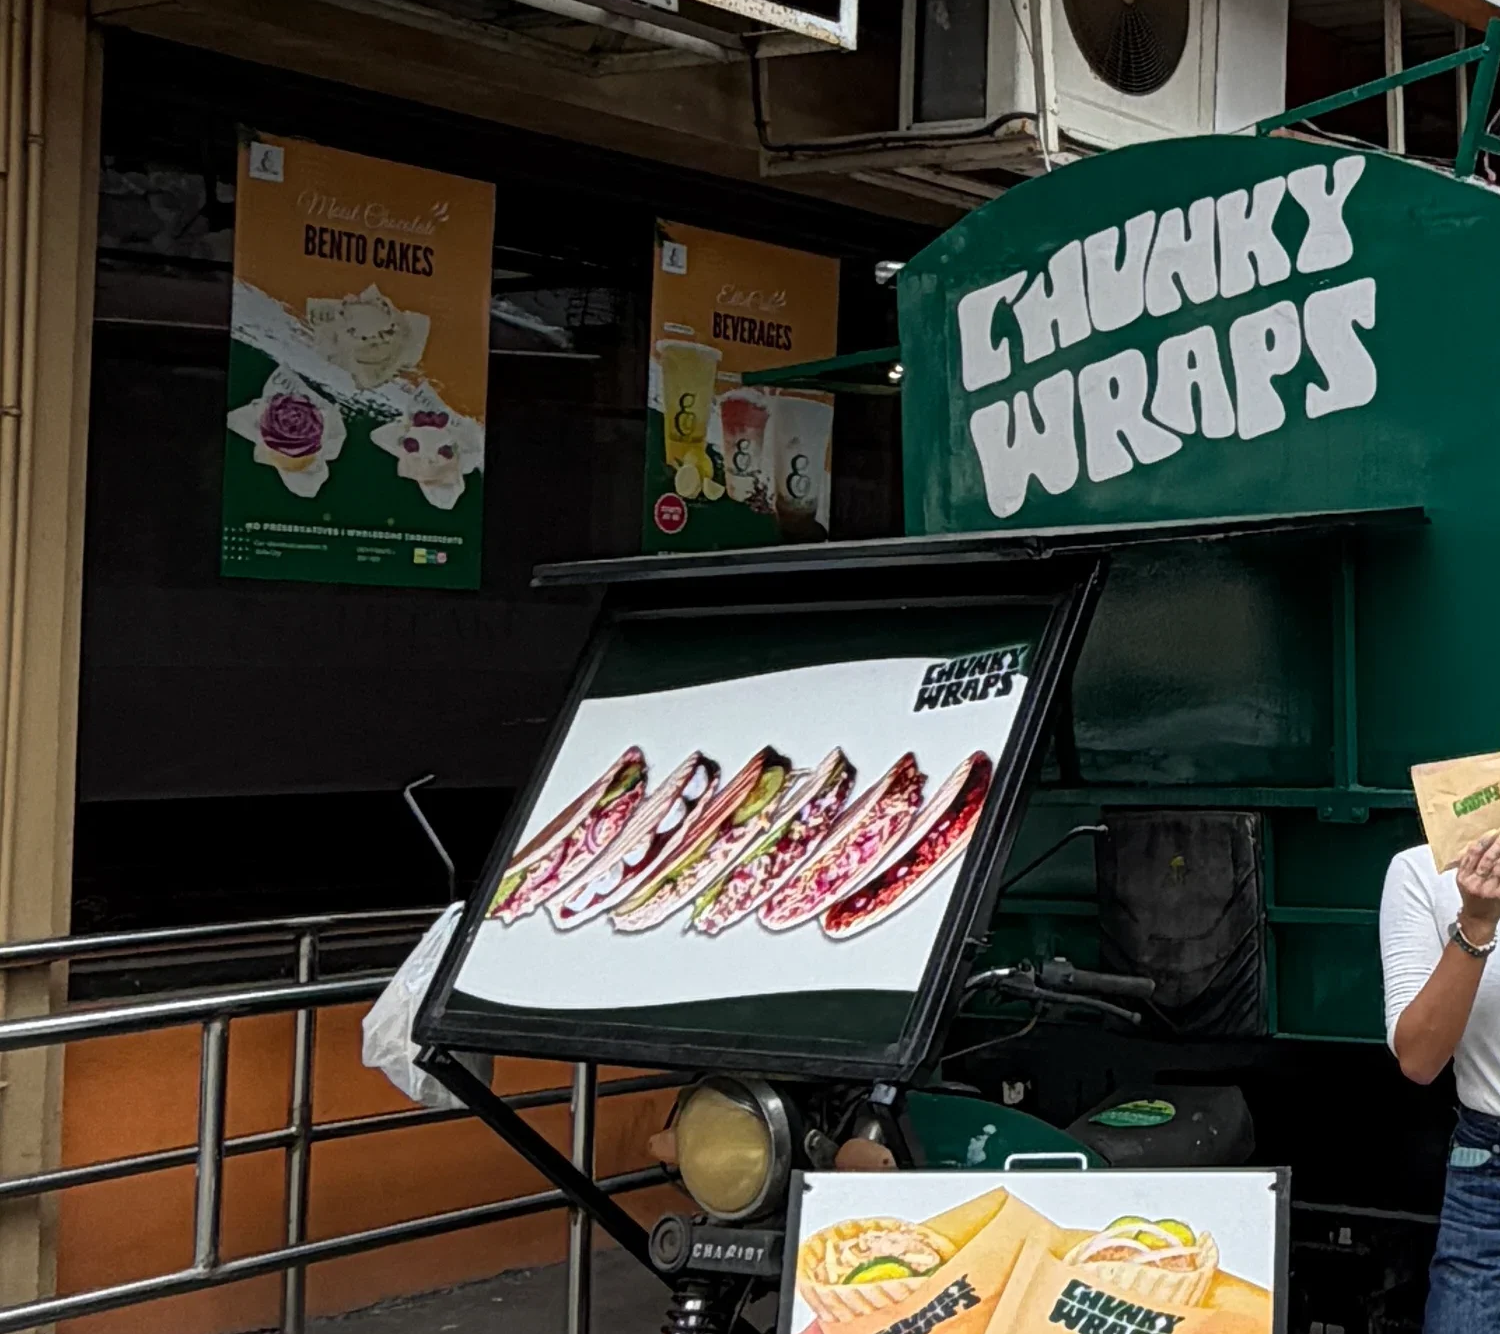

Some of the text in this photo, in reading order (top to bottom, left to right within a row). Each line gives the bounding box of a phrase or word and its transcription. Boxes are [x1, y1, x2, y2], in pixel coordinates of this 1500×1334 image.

[304, 224, 434, 277] BENTO CAKES
[957, 155, 1366, 392] CHUNKY
[713, 311, 793, 352] BEVERAGES
[970, 277, 1377, 519] WRAPS
[921, 644, 1028, 686] CHUNKY
[913, 670, 1019, 712] WRAPS
[692, 1243, 764, 1262] CHARIOT
[1061, 1278, 1185, 1334] CHUNKY
